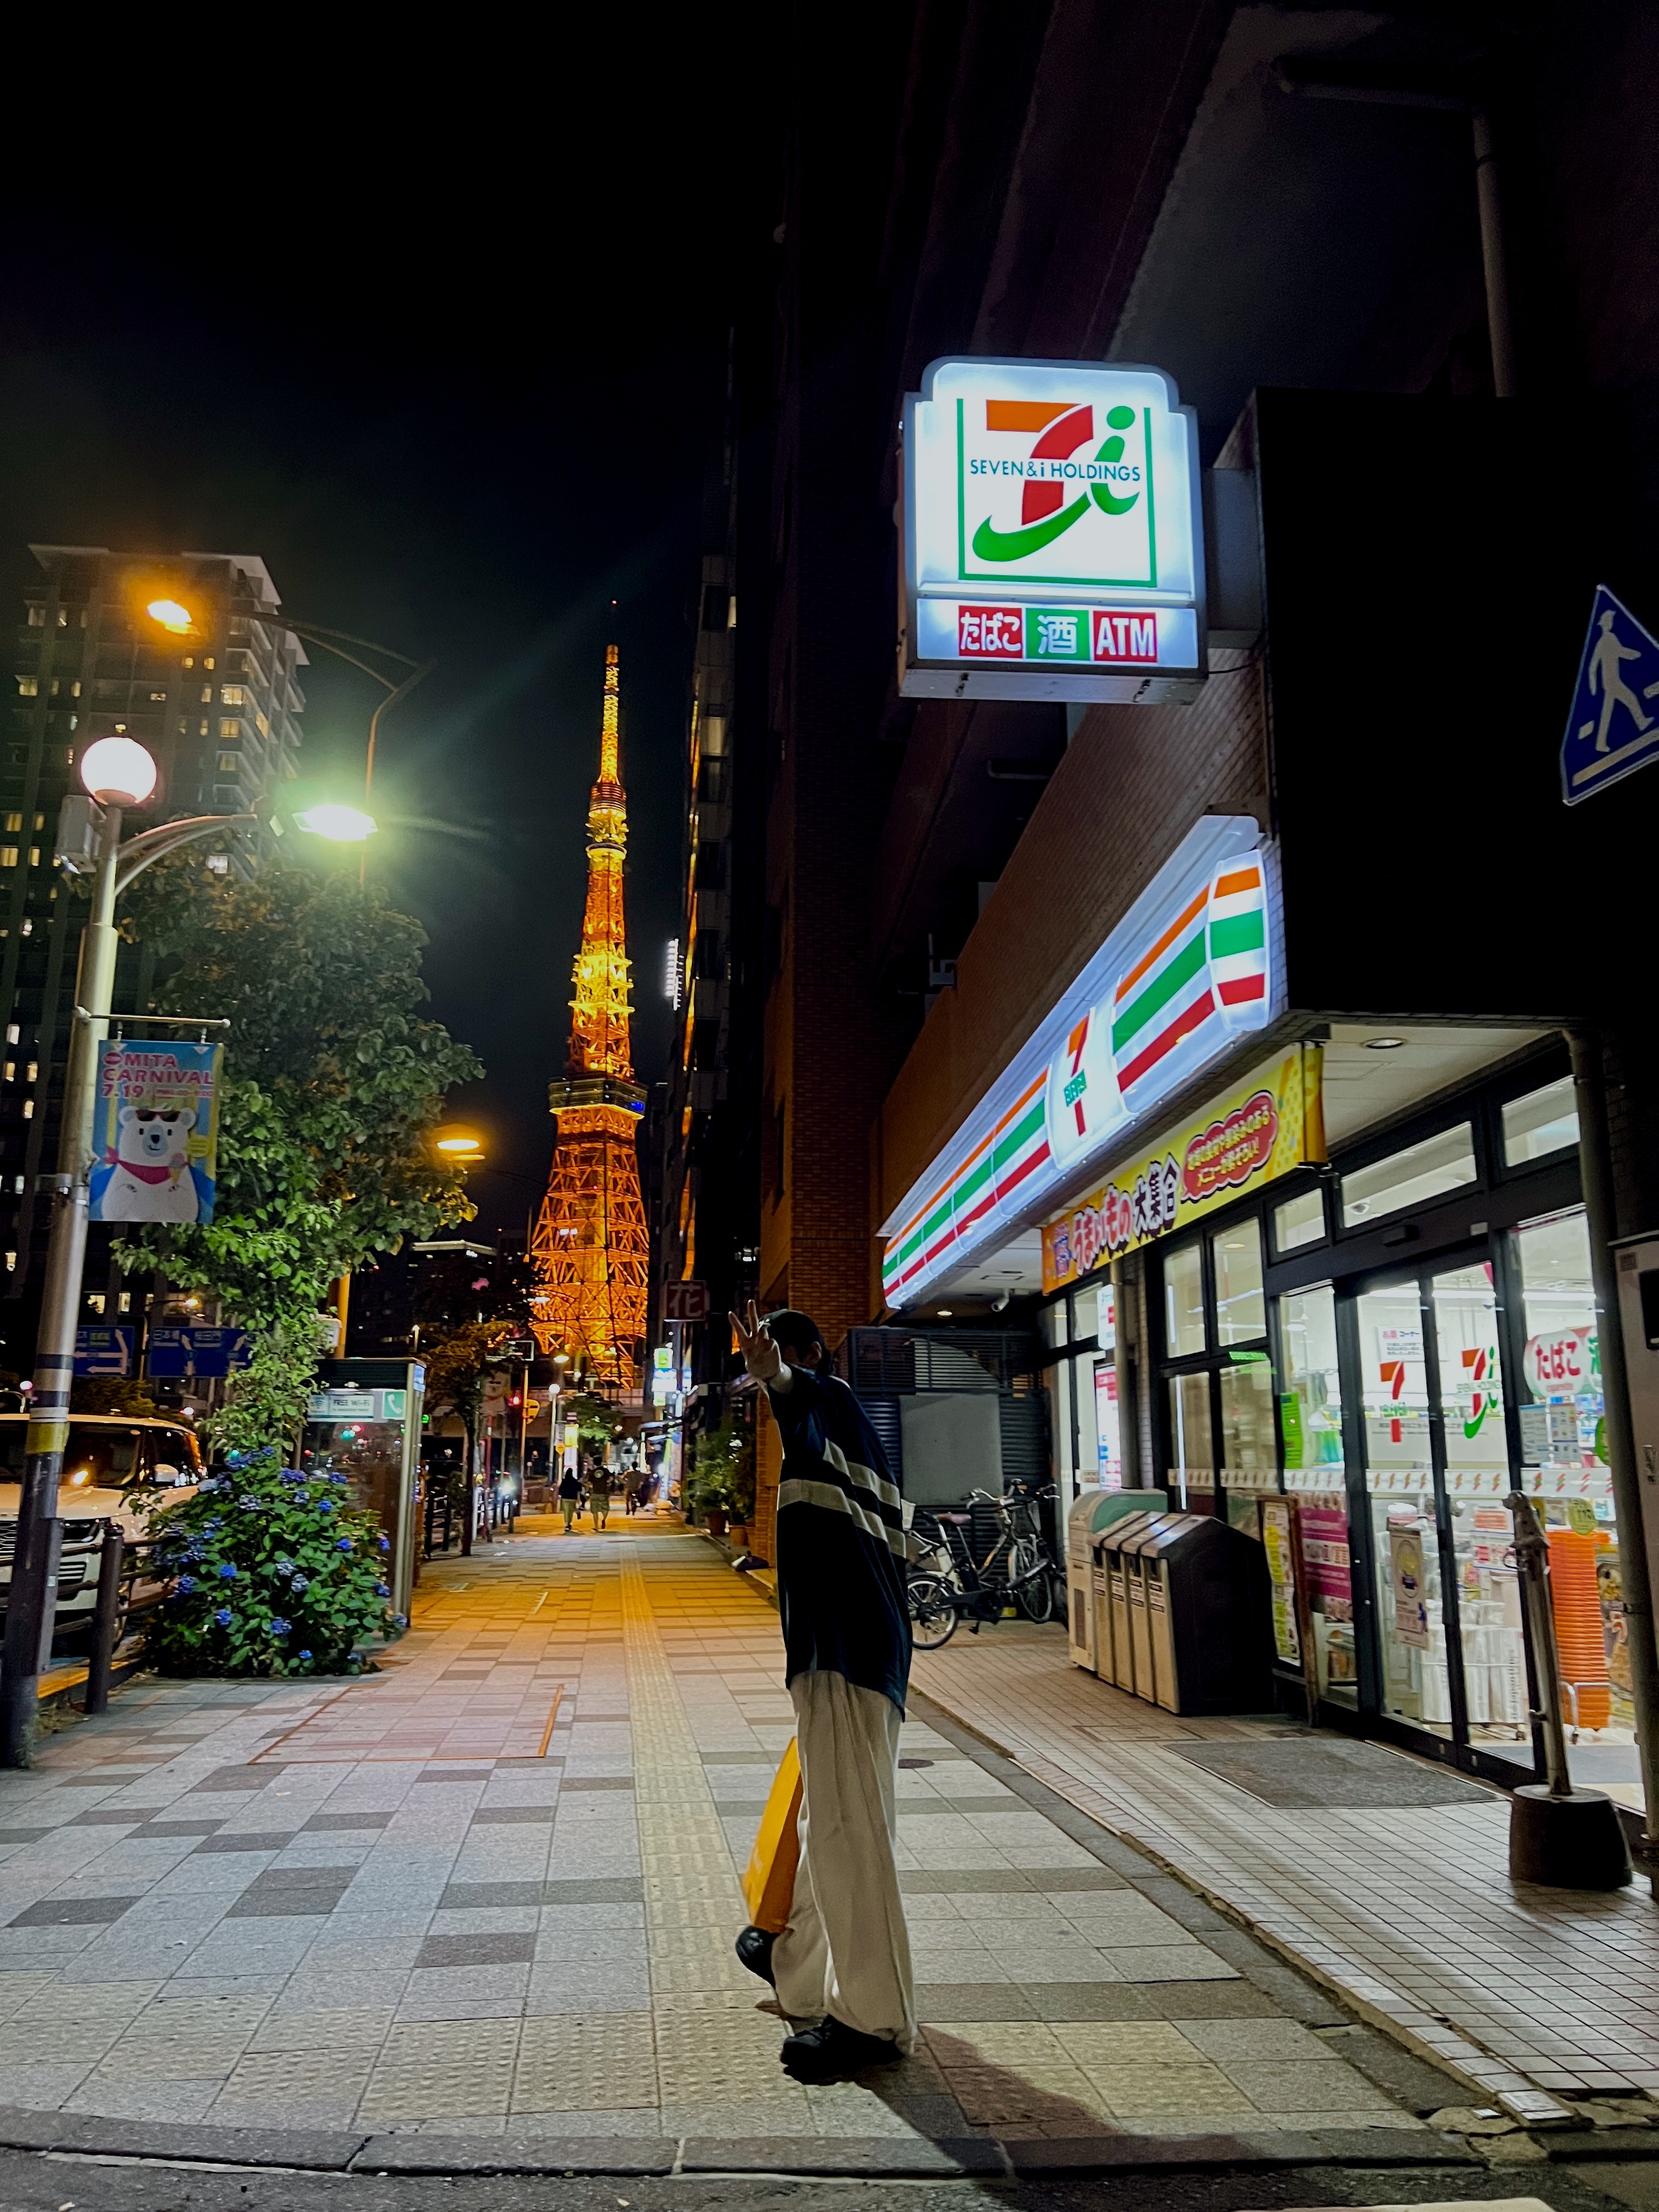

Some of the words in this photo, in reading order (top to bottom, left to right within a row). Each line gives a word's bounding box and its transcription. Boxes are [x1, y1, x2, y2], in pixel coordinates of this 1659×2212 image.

[1051, 463, 1141, 481] HOLDINGS
[960, 612, 1022, 652] たばこ
[1037, 614, 1078, 654] 酒
[1096, 617, 1154, 656] ATM
[124, 1053, 177, 1068] MITA
[103, 1068, 214, 1085] CARNIVAL
[669, 1283, 703, 1317] 花
[1536, 1339, 1581, 1381] たばこ
